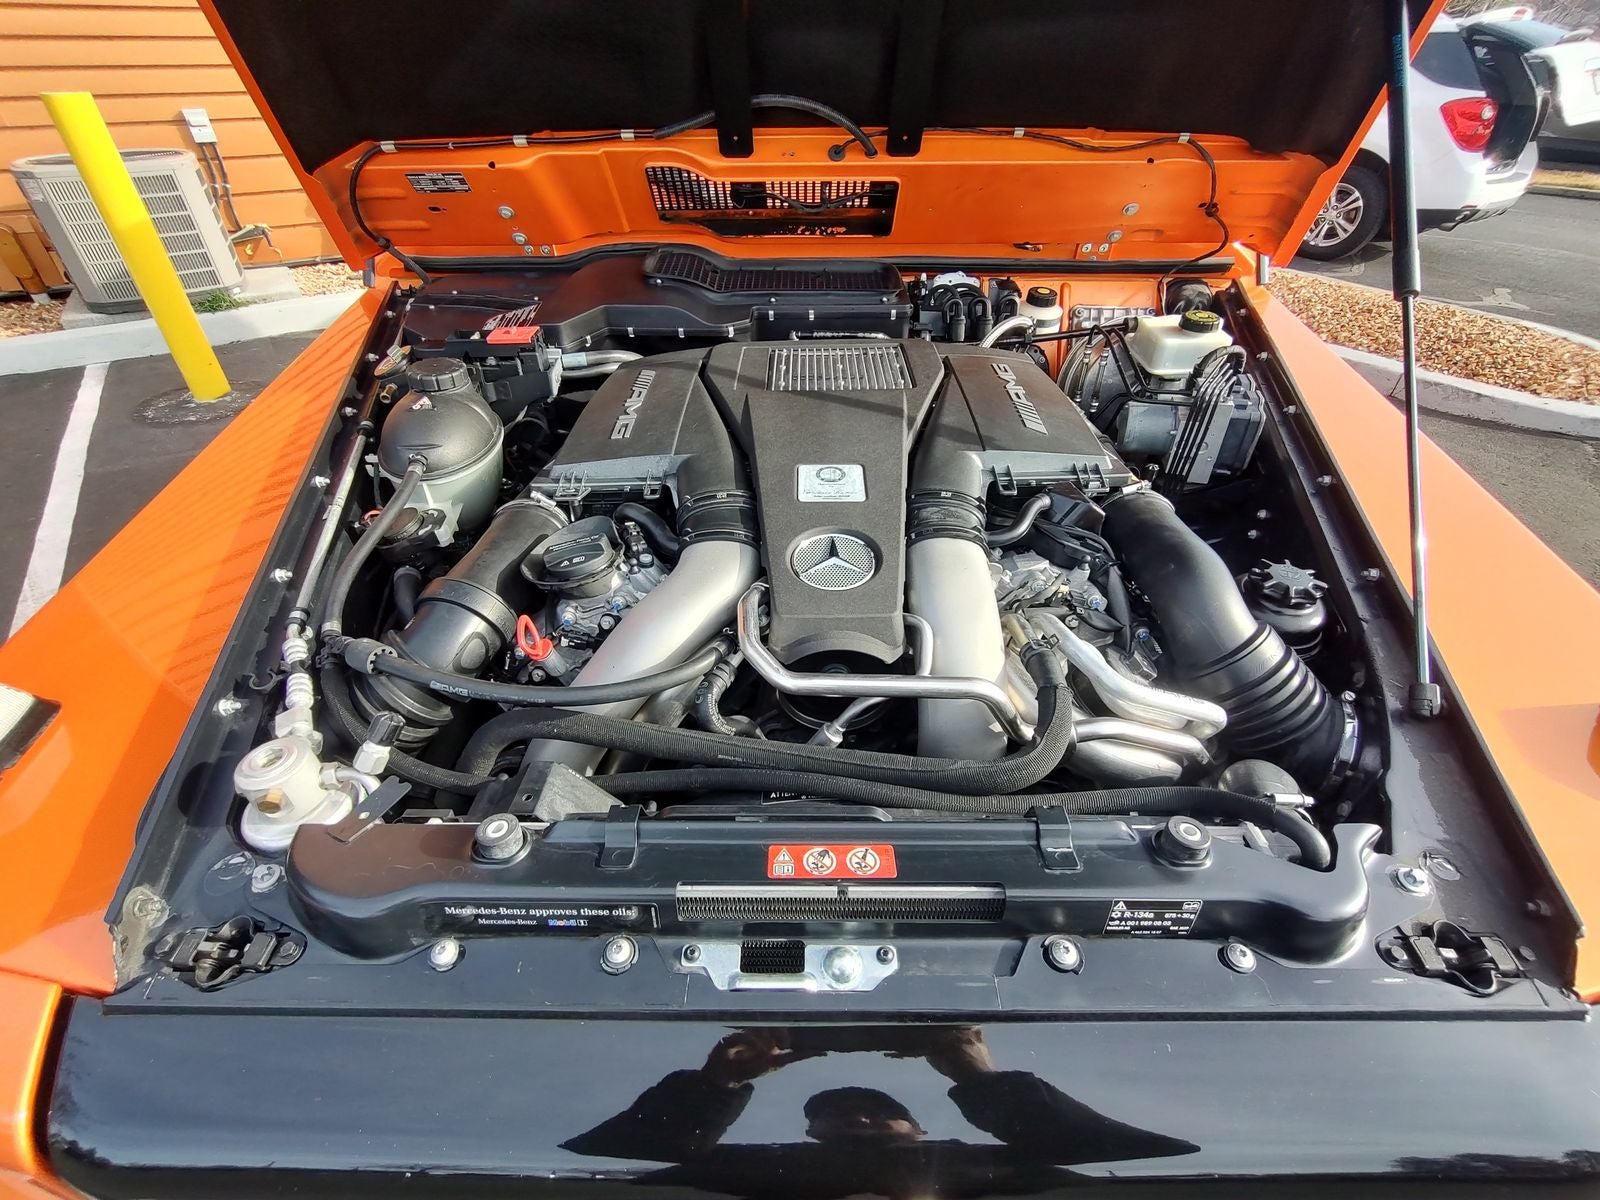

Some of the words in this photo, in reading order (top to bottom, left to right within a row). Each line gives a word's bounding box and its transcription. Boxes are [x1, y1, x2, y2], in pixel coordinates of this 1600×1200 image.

[444, 905, 527, 915] Mercedes-Benz
[529, 907, 578, 918] approves
[580, 907, 610, 916] these
[1123, 911, 1155, 919] R-134a
[478, 918, 538, 926] Mercedes-Benz
[548, 919, 577, 927] Mobil
